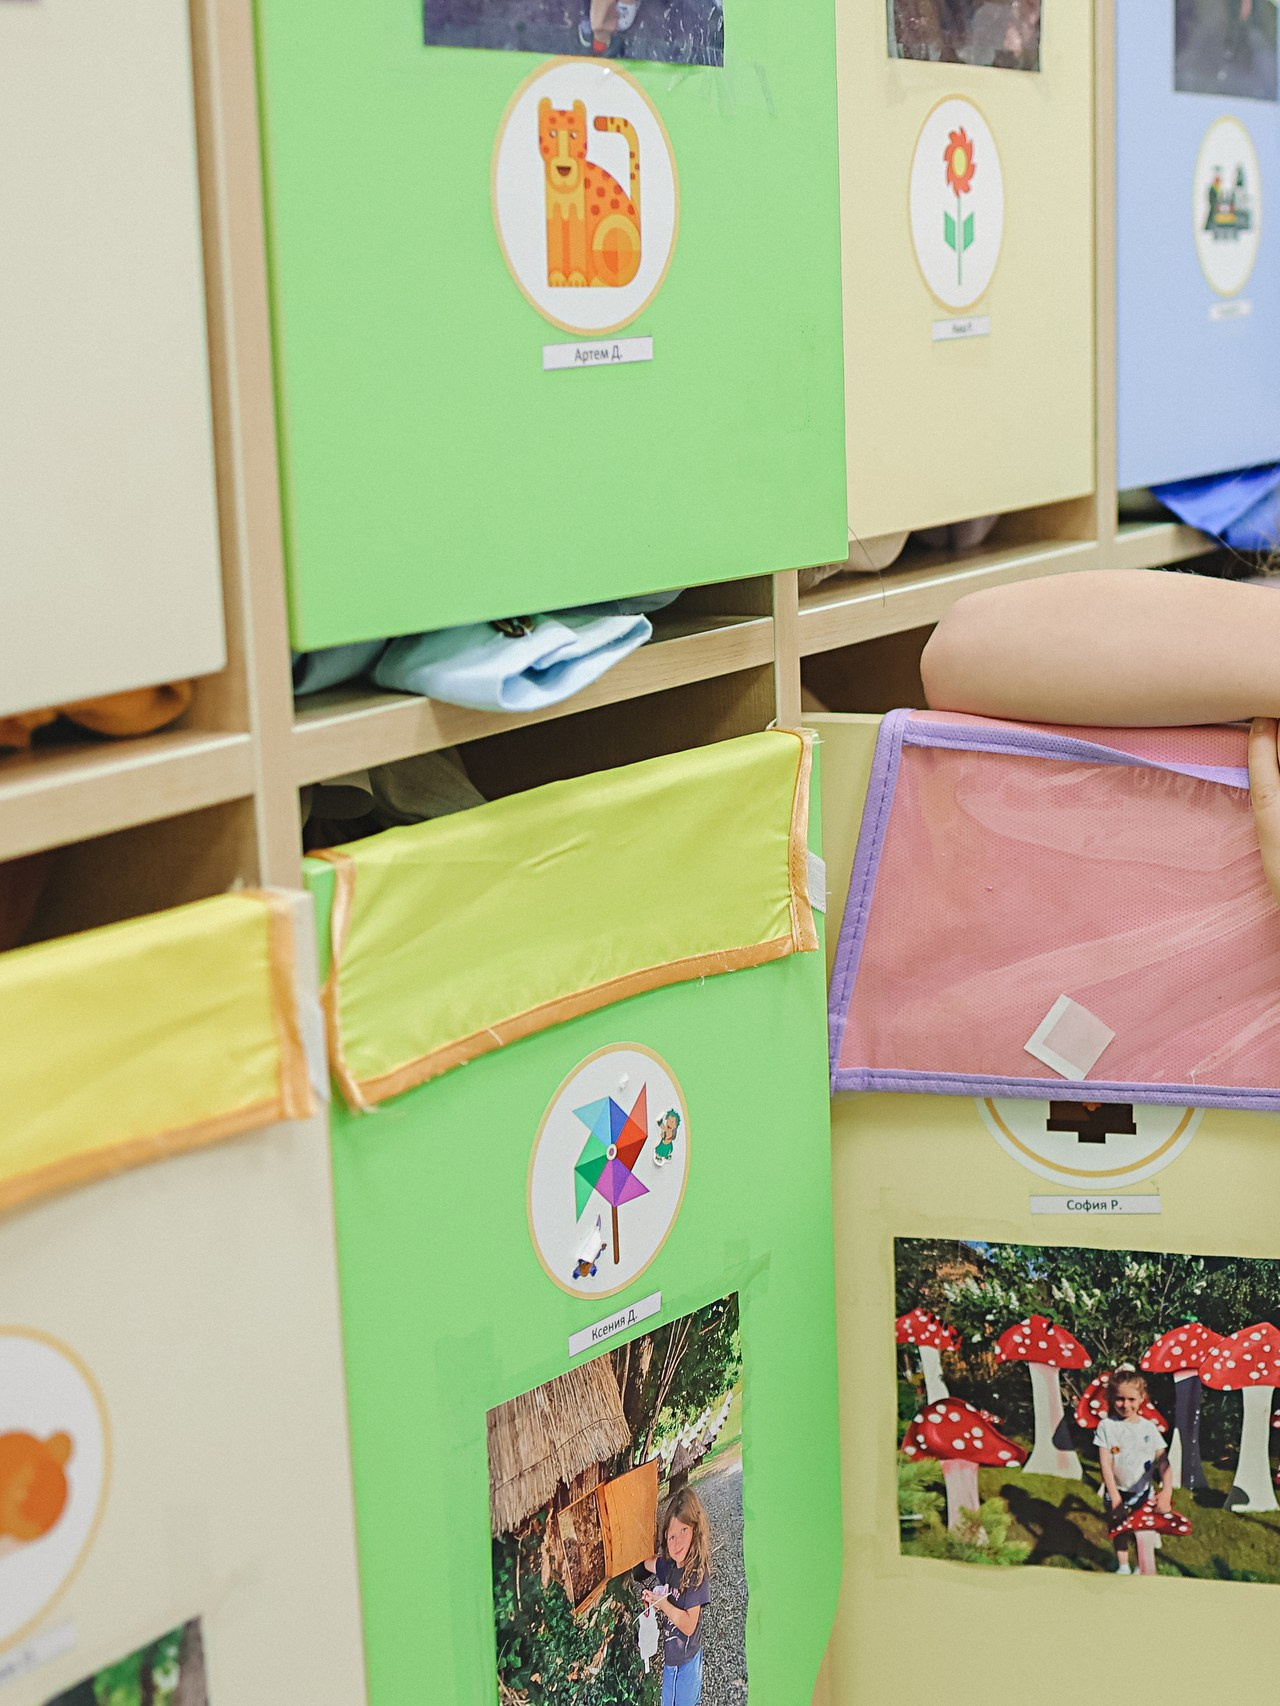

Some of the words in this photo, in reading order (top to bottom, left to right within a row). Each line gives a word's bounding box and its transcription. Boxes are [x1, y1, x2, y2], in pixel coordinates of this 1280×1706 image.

[574, 347, 609, 365] Артем
[610, 344, 623, 361] Д.
[1066, 1199, 1107, 1213] София
[1111, 1199, 1123, 1211] Р.
[591, 1316, 625, 1341] Ксения
[627, 1309, 638, 1326] Д.
